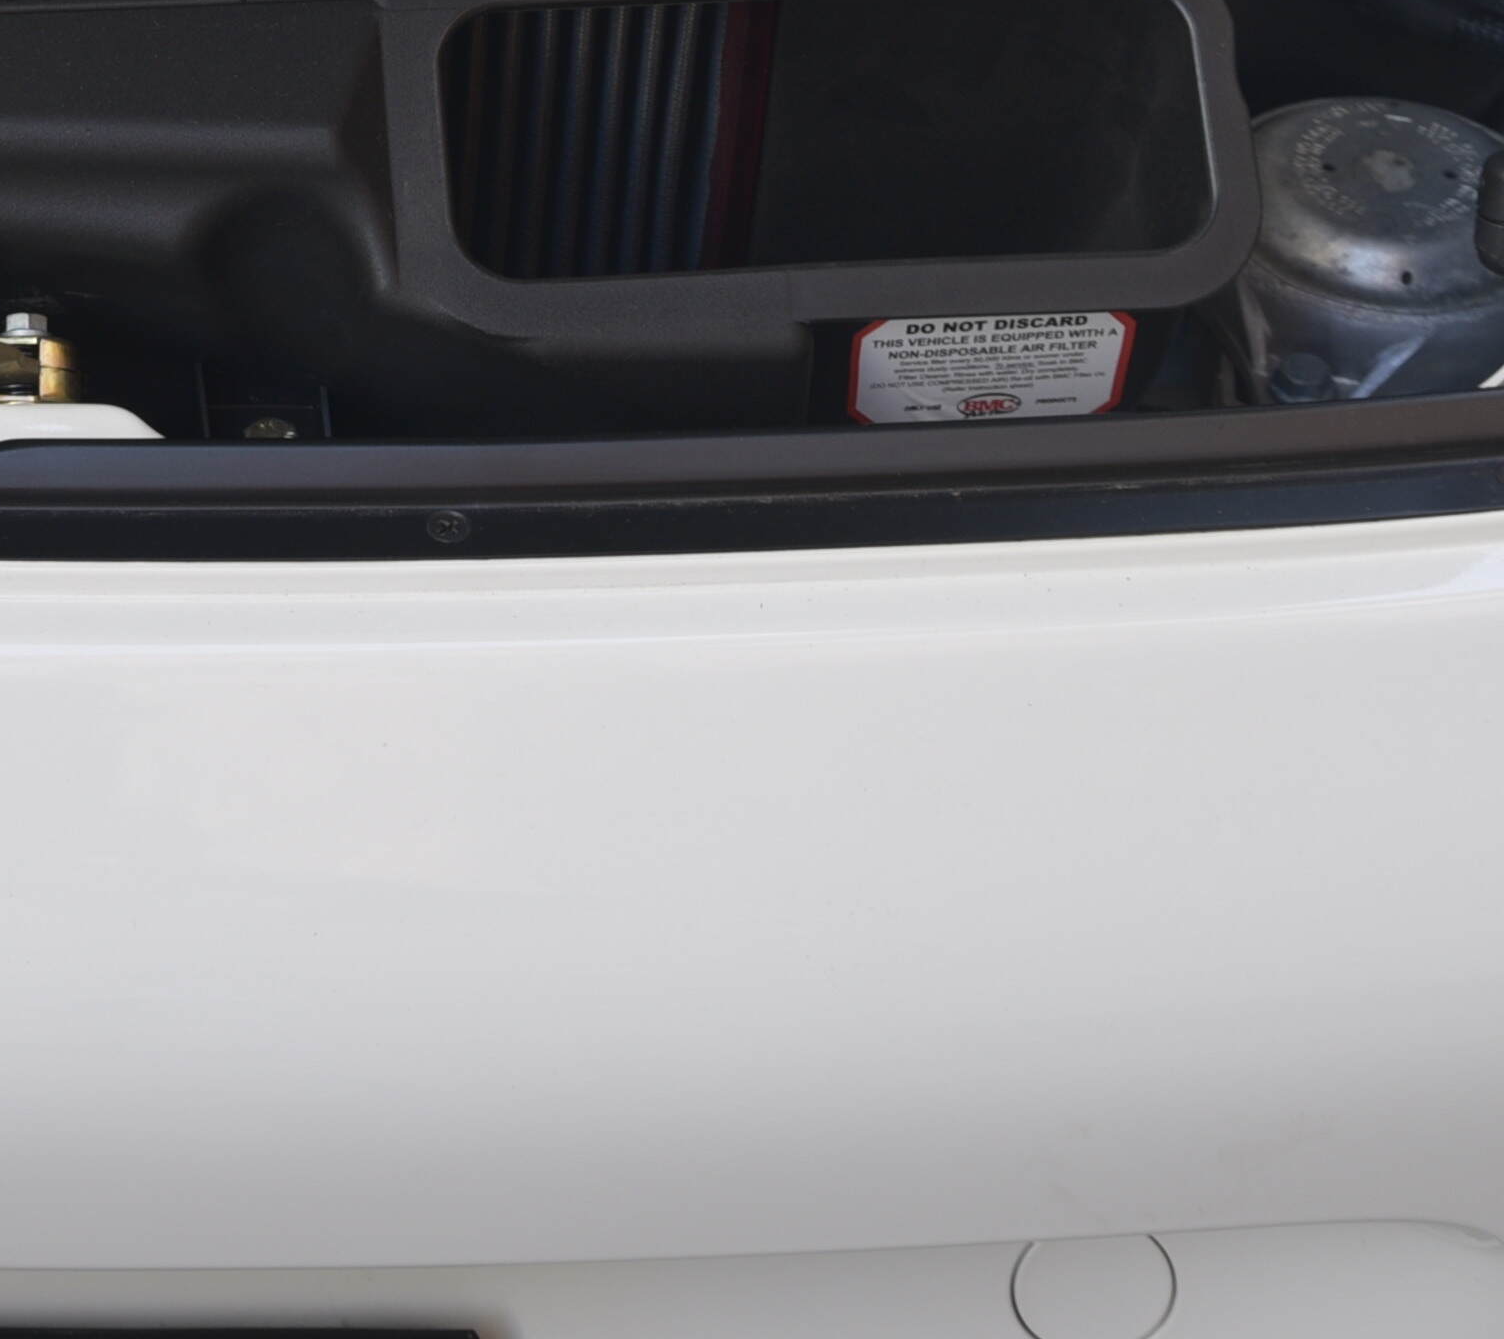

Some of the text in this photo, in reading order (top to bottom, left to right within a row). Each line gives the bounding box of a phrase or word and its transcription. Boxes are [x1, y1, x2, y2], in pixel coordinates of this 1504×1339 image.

[905, 315, 1088, 335] DO NOT DISCARD
[872, 327, 1118, 348] THIS VEHICLE IS EQUIPPED WITH A
[888, 344, 1017, 360] NON-DISPOSABLE
[1020, 342, 1045, 353] AIR
[1048, 340, 1097, 351] FILTER
[963, 398, 1016, 412] BMC
